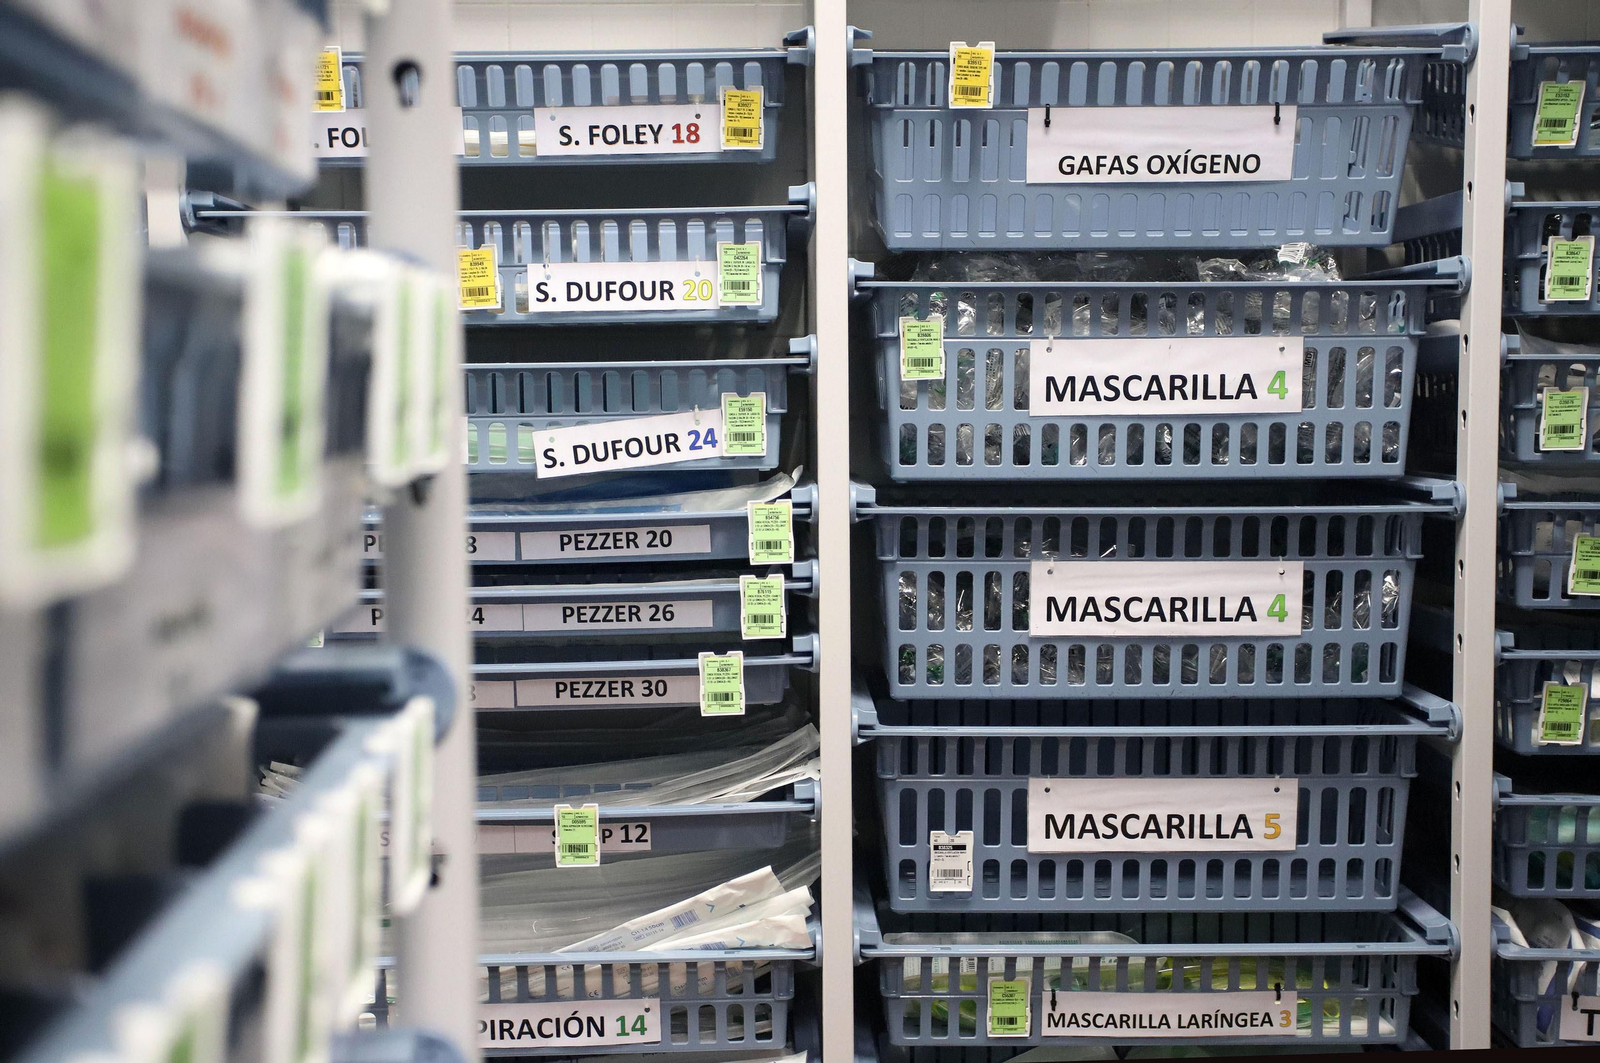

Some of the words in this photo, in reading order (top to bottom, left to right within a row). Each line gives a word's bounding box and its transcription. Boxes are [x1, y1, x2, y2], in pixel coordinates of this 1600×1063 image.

[560, 126, 579, 146] S.
[589, 124, 663, 145] FOLEY
[672, 123, 700, 144] 18
[1059, 155, 1138, 175] GAFAS
[1147, 149, 1260, 174] OXÍGENO
[536, 281, 556, 302] S.
[567, 281, 675, 302] DUFOUR
[683, 280, 713, 301] 20
[1045, 374, 1258, 402] MASCARILLA
[1267, 371, 1288, 400] 4
[544, 447, 564, 469] S.
[573, 433, 681, 464] DUFOUR
[688, 428, 718, 451] 24
[559, 531, 639, 552] PEZZER
[646, 529, 673, 549] 20
[470, 606, 485, 625] 4
[562, 604, 641, 624] PEZZER
[648, 603, 675, 622] 26
[1046, 596, 1258, 623] MASCARILLA
[1267, 594, 1288, 622] 4
[555, 679, 634, 699] PEZZER
[641, 679, 668, 698] 30
[620, 823, 649, 844] 12
[1045, 813, 1254, 840] MASCARILLA
[1263, 813, 1282, 840] 5
[616, 1015, 648, 1037] 14
[1048, 1012, 1171, 1029] MASCARILLA
[1178, 1009, 1273, 1029] LARÍNGEA
[1279, 1010, 1292, 1027] 3
